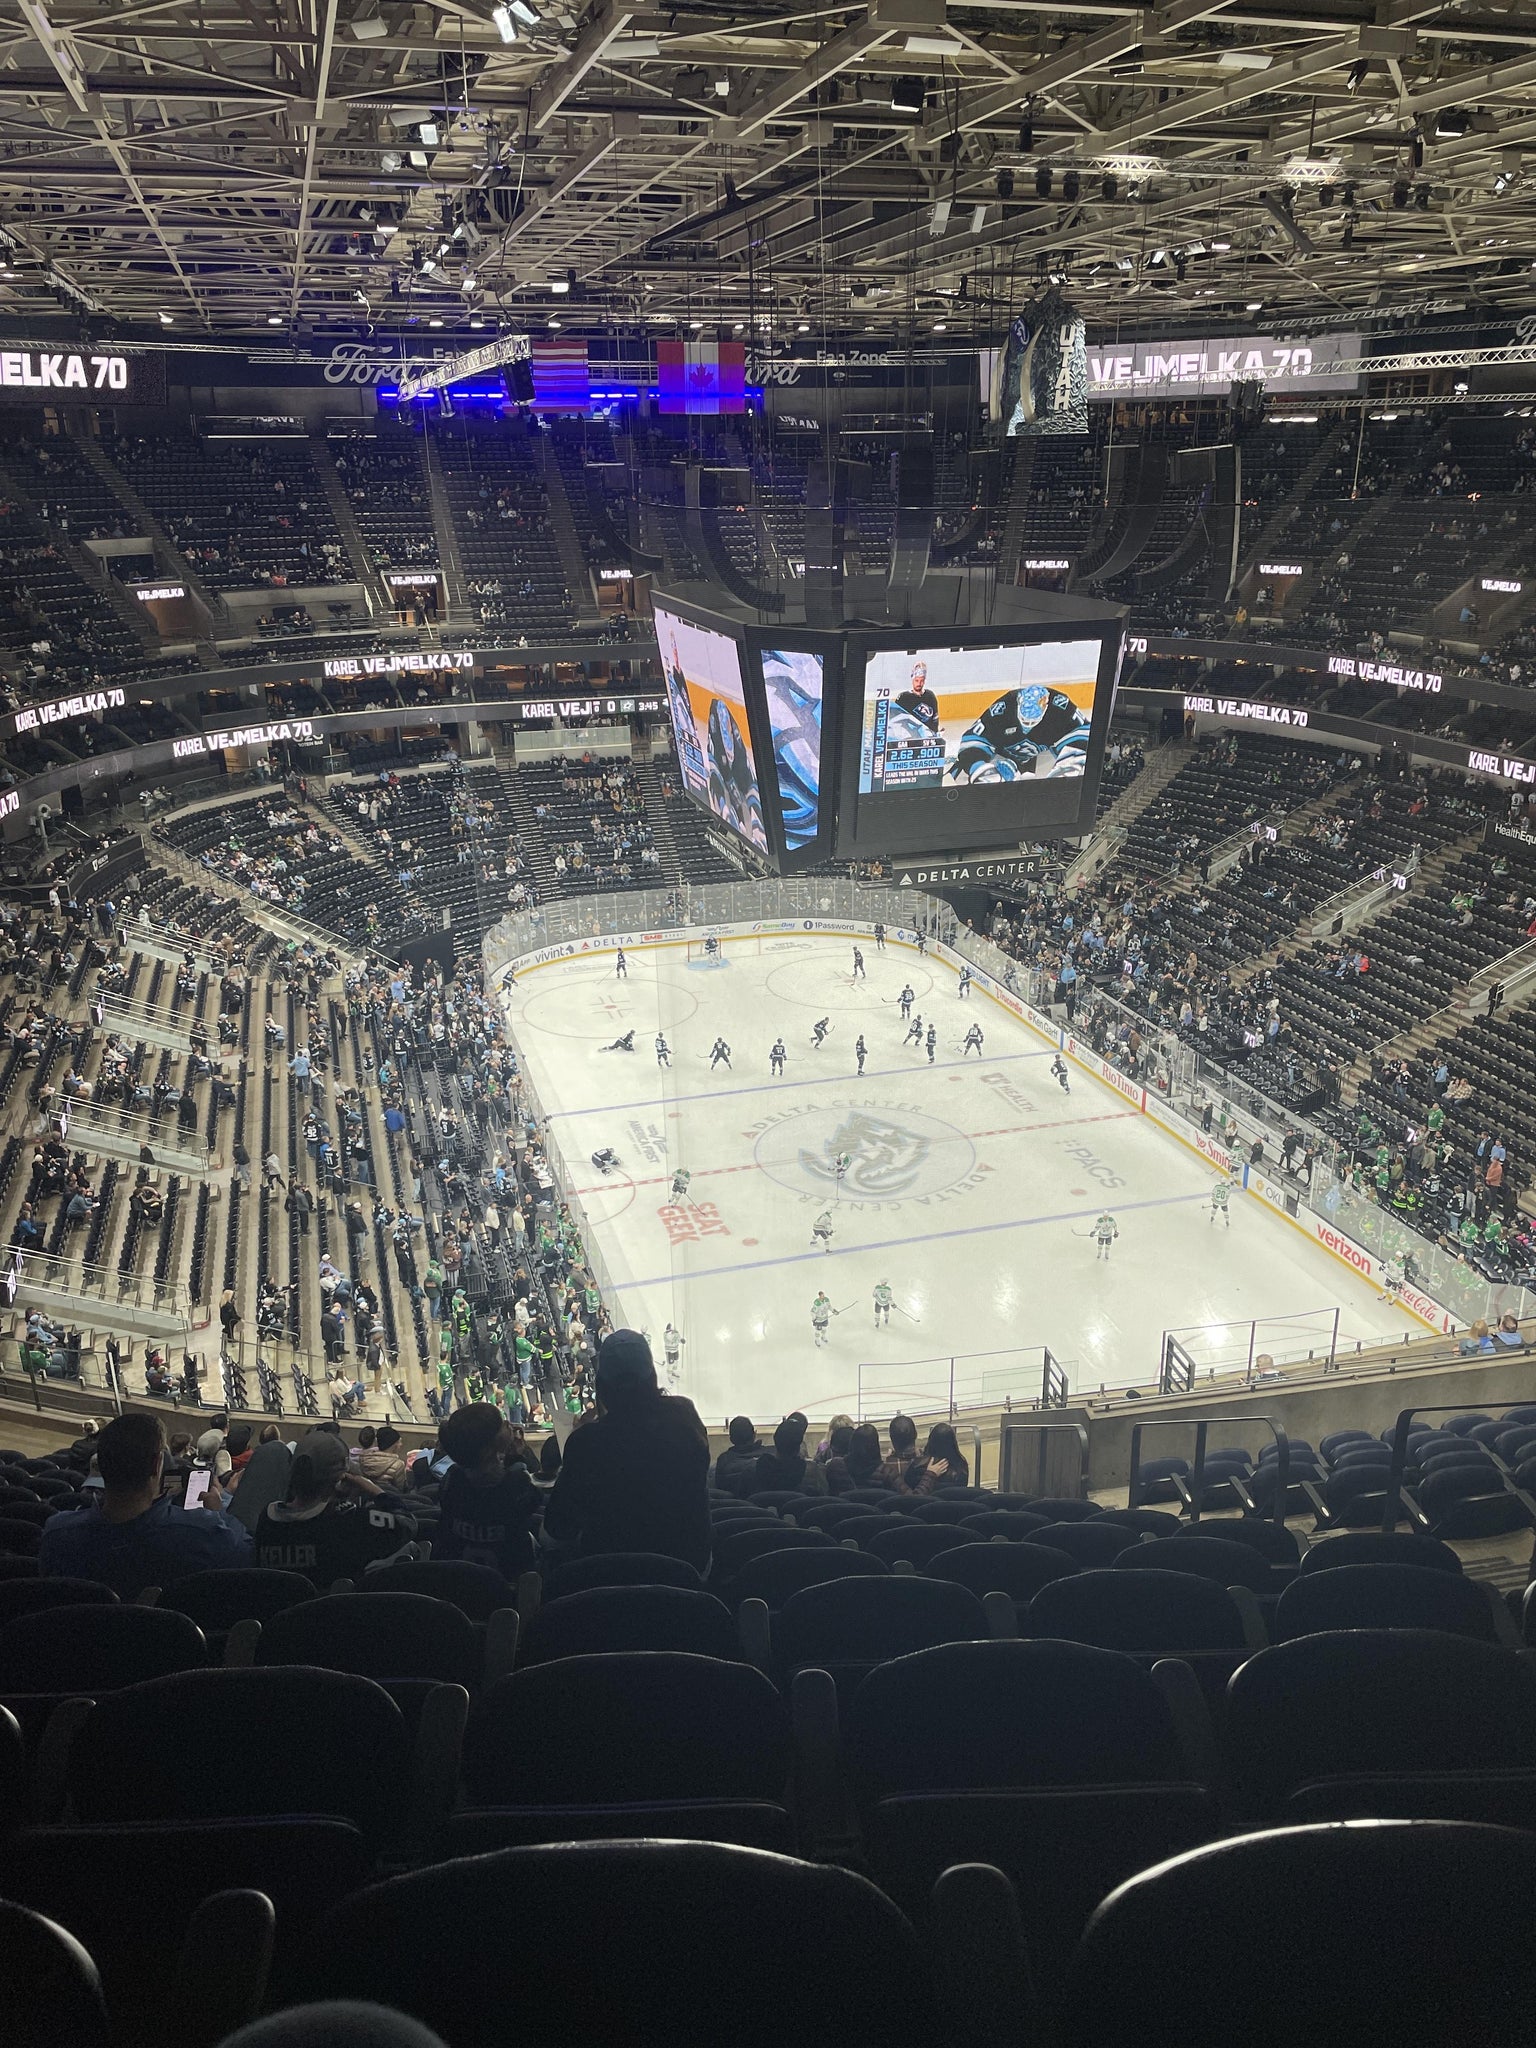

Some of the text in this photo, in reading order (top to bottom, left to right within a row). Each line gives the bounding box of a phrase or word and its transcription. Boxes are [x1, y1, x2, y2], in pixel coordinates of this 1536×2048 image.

[0, 352, 127, 389] ELKA 70
[1053, 324, 1076, 411] UTAH
[1091, 348, 1312, 384] VEJMELKA 70
[1025, 560, 1069, 569] VEJMELKA
[1259, 564, 1303, 575] VEJMELKA
[389, 574, 438, 586] VEJMELKA
[1481, 579, 1522, 593] VEJMELKA
[136, 587, 185, 601] VEJMELKA
[1129, 638, 1147, 653] 70
[324, 652, 474, 677] KAREL VEJMELKA 70
[1328, 656, 1442, 693] KAREL VEJMELKA 70
[876, 688, 890, 698] 70
[14, 688, 125, 733] KAREL VEJMELKA 70
[521, 703, 558, 719] KAREL
[558, 701, 592, 716] VEJ
[1184, 696, 1308, 727] KAREL VEJMELKA 70
[172, 736, 207, 758] KAREL
[206, 723, 292, 751] VEJMELKA
[292, 721, 313, 738] 70
[873, 700, 888, 778] KAREL VEJMELKA
[862, 750, 871, 775] UTAH
[891, 748, 940, 760] 2.62 .900
[892, 760, 938, 770] THIS SEASON
[1468, 750, 1536, 784] KAREL VEJ
[6, 790, 20, 813] 70
[1265, 825, 1277, 841] 70
[917, 861, 1035, 883] DELTA CENTER
[1392, 872, 1406, 890] 70
[814, 921, 855, 931] 1Password
[593, 936, 634, 948] DELTA
[535, 946, 566, 963] vivint
[1032, 1015, 1044, 1028] Ken
[1244, 1031, 1257, 1048] 70
[752, 1099, 923, 1131] DELTA CENTER
[1065, 1148, 1127, 1190] PACS
[1216, 1190, 1226, 1199] 20
[656, 1205, 701, 1246] GEEK
[687, 1201, 732, 1237] SEAT
[1317, 1223, 1371, 1276] verizon
